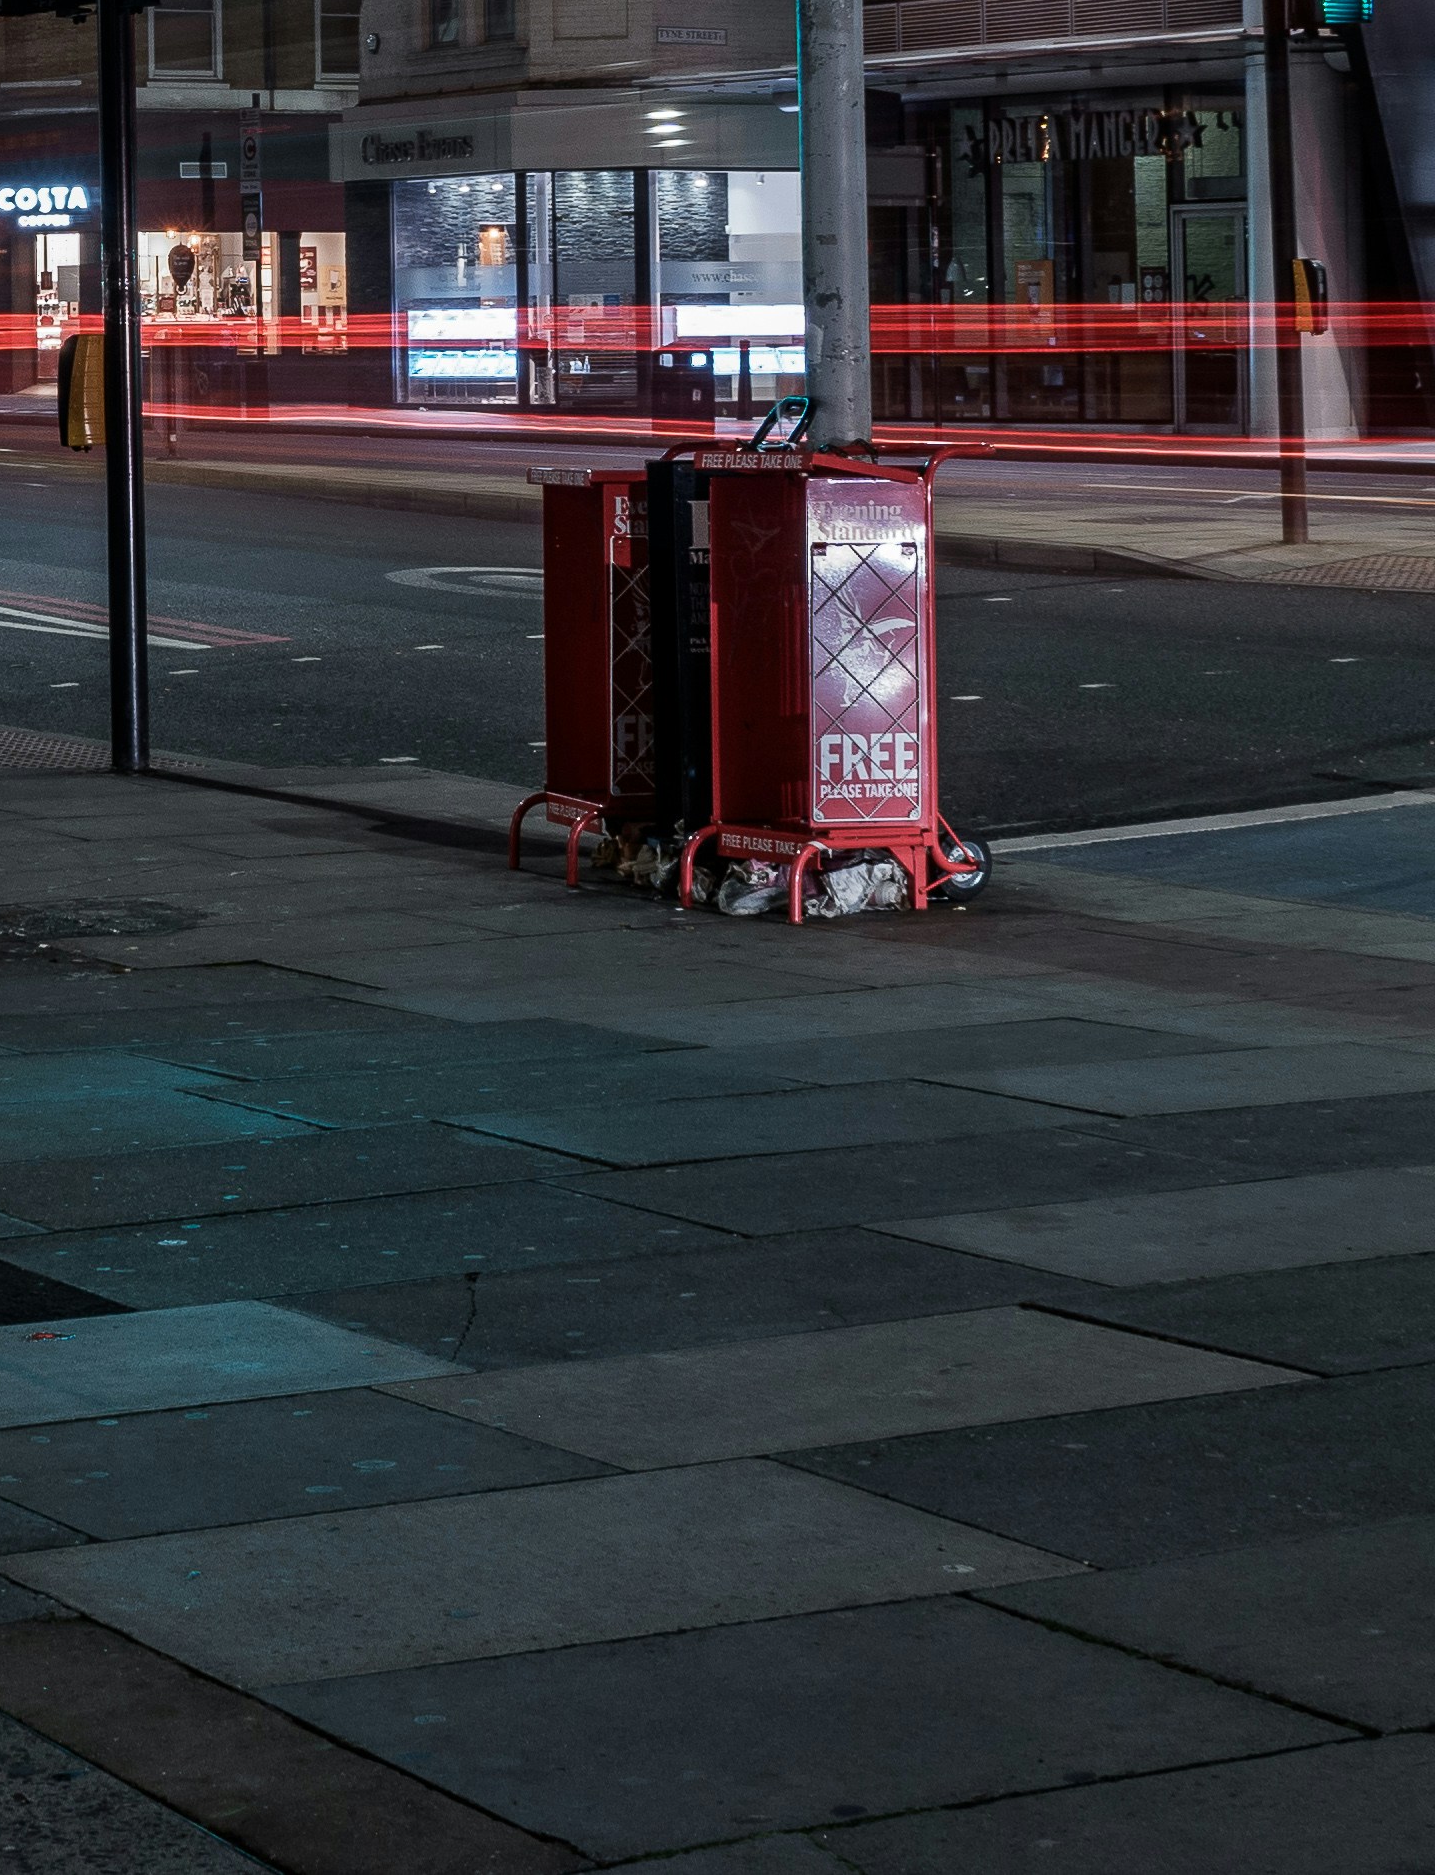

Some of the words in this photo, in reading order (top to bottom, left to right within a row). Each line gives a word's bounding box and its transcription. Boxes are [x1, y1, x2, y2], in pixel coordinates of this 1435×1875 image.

[659, 29, 684, 39] TYNE
[685, 30, 719, 41] STREET
[988, 116, 1041, 164] PRET
[1069, 108, 1162, 160] MANGER
[361, 133, 415, 165] Chase
[416, 130, 474, 161] Evans
[701, 454, 724, 468] FREE
[725, 454, 759, 469] PLEASE
[761, 454, 782, 469] TAKE
[784, 454, 803, 469] ONE
[811, 499, 903, 521] Evening
[818, 522, 917, 541] Standard
[820, 732, 918, 781] FREE
[820, 784, 863, 799] PLEASE
[865, 783, 893, 798] TAKE
[894, 782, 919, 798] ONE
[721, 832, 741, 848] FREE
[742, 835, 773, 852] PLEASE
[775, 839, 795, 854] TAKE
